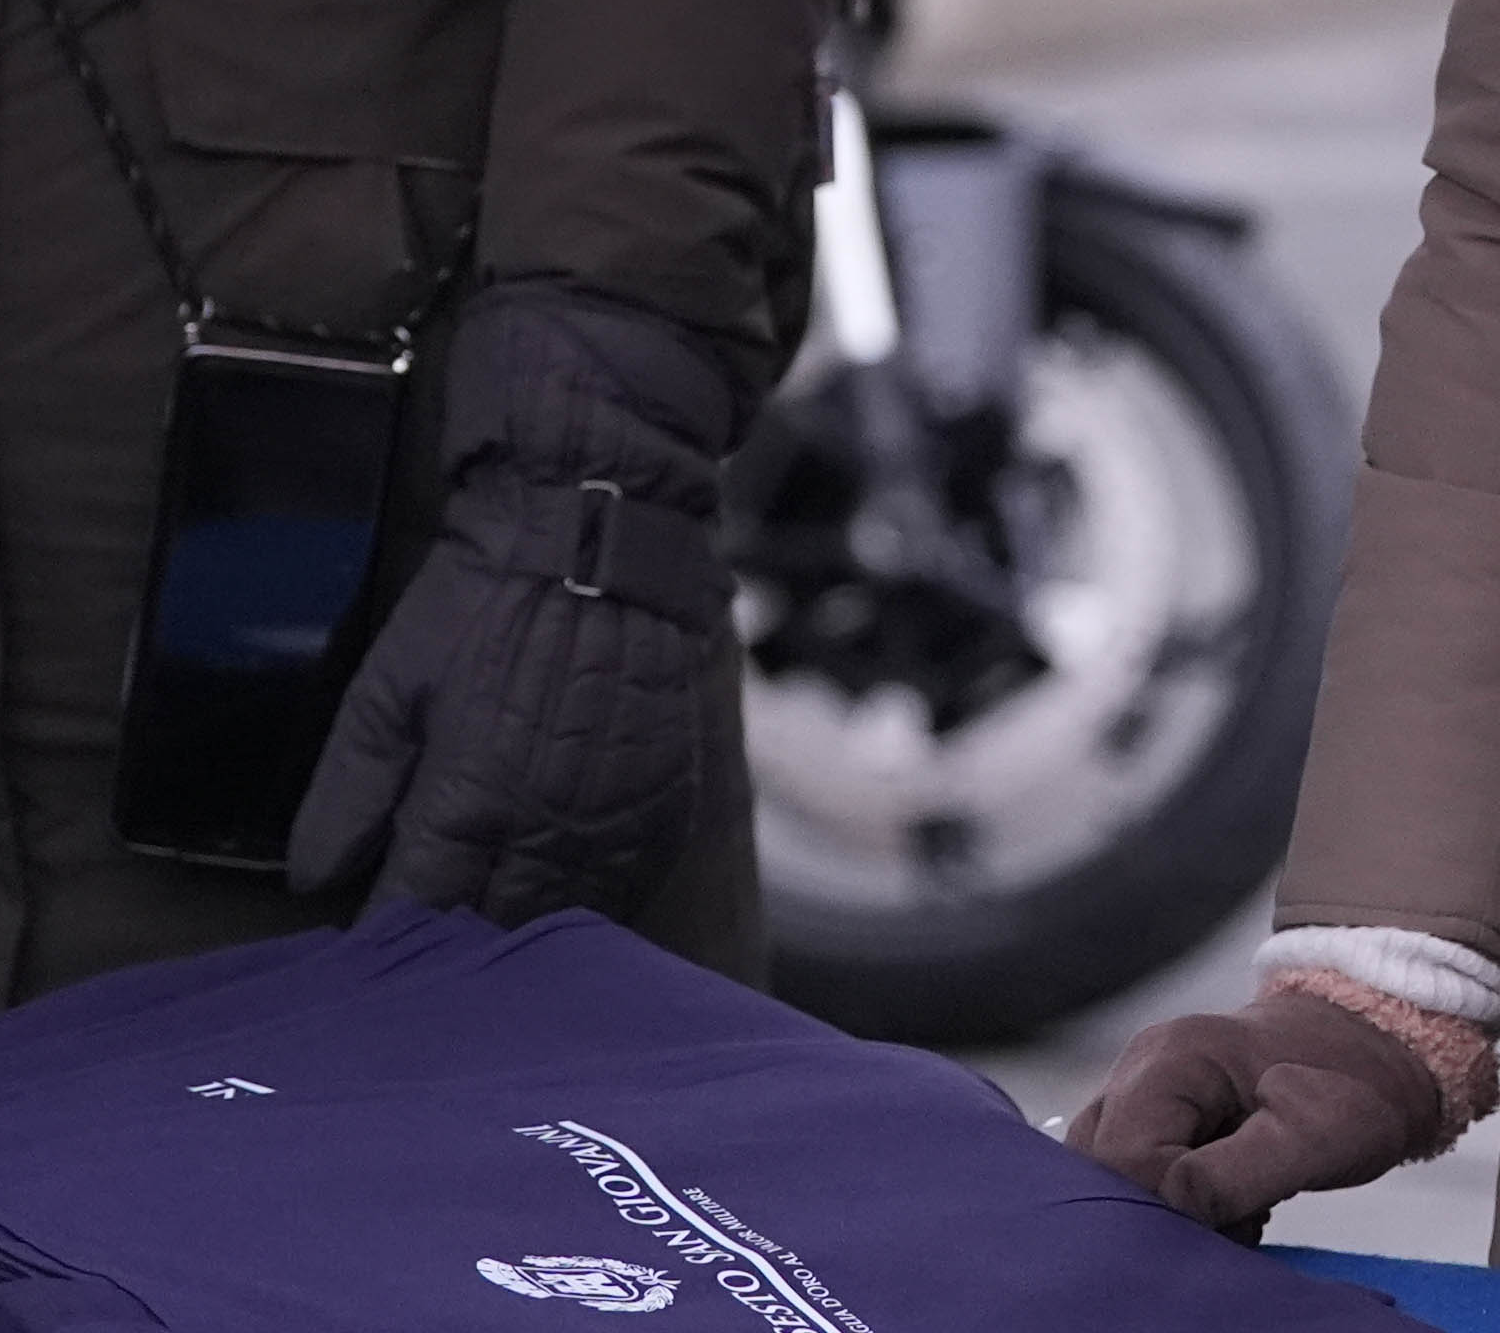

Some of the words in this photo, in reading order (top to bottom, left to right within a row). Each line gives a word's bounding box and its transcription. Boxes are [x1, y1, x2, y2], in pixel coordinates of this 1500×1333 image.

[512, 1123, 671, 1225] GIOVANNI
[682, 1186, 746, 1231] MILITARE
[652, 1229, 735, 1265] SAN
